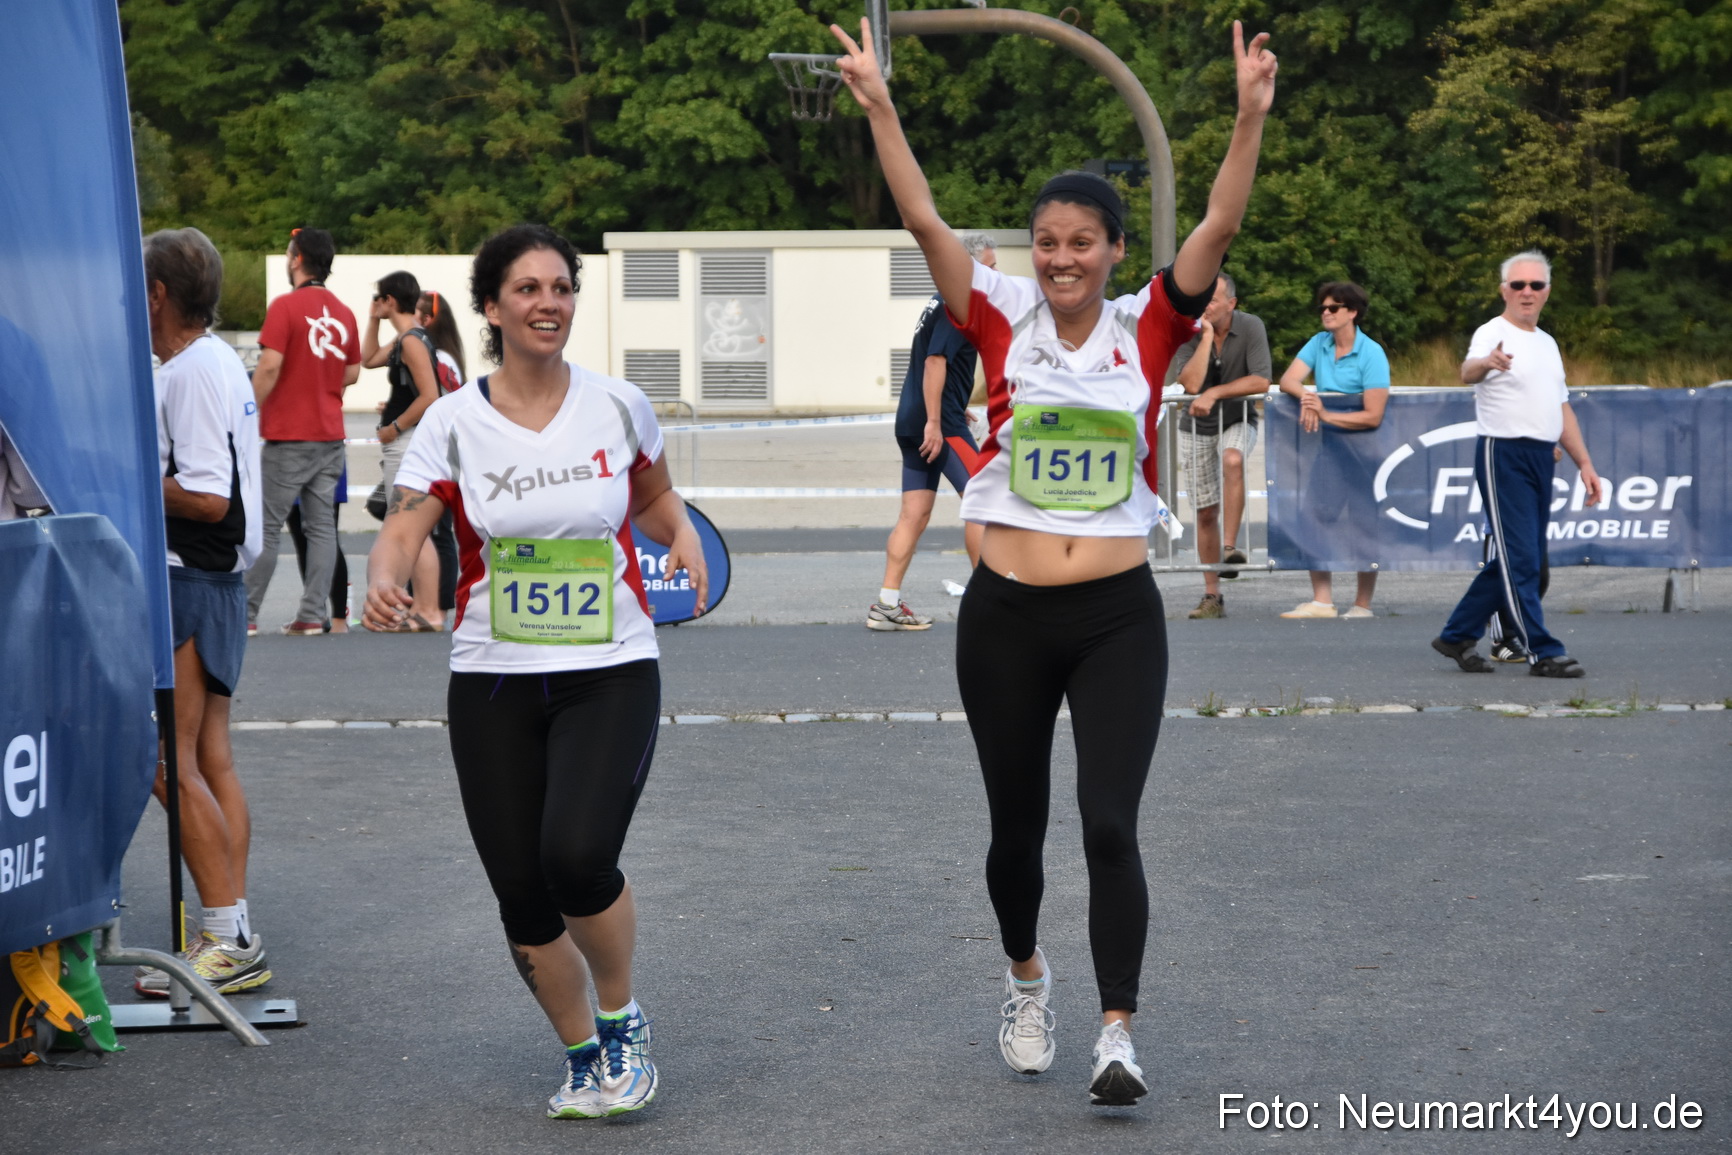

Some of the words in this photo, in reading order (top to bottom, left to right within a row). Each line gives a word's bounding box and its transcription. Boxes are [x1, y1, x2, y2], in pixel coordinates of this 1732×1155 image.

[1025, 448, 1117, 482] 1511
[1064, 488, 1097, 496] Joedicke
[503, 581, 600, 616] 1512
[519, 621, 545, 630] Verena
[546, 623, 582, 631] Vanselow
